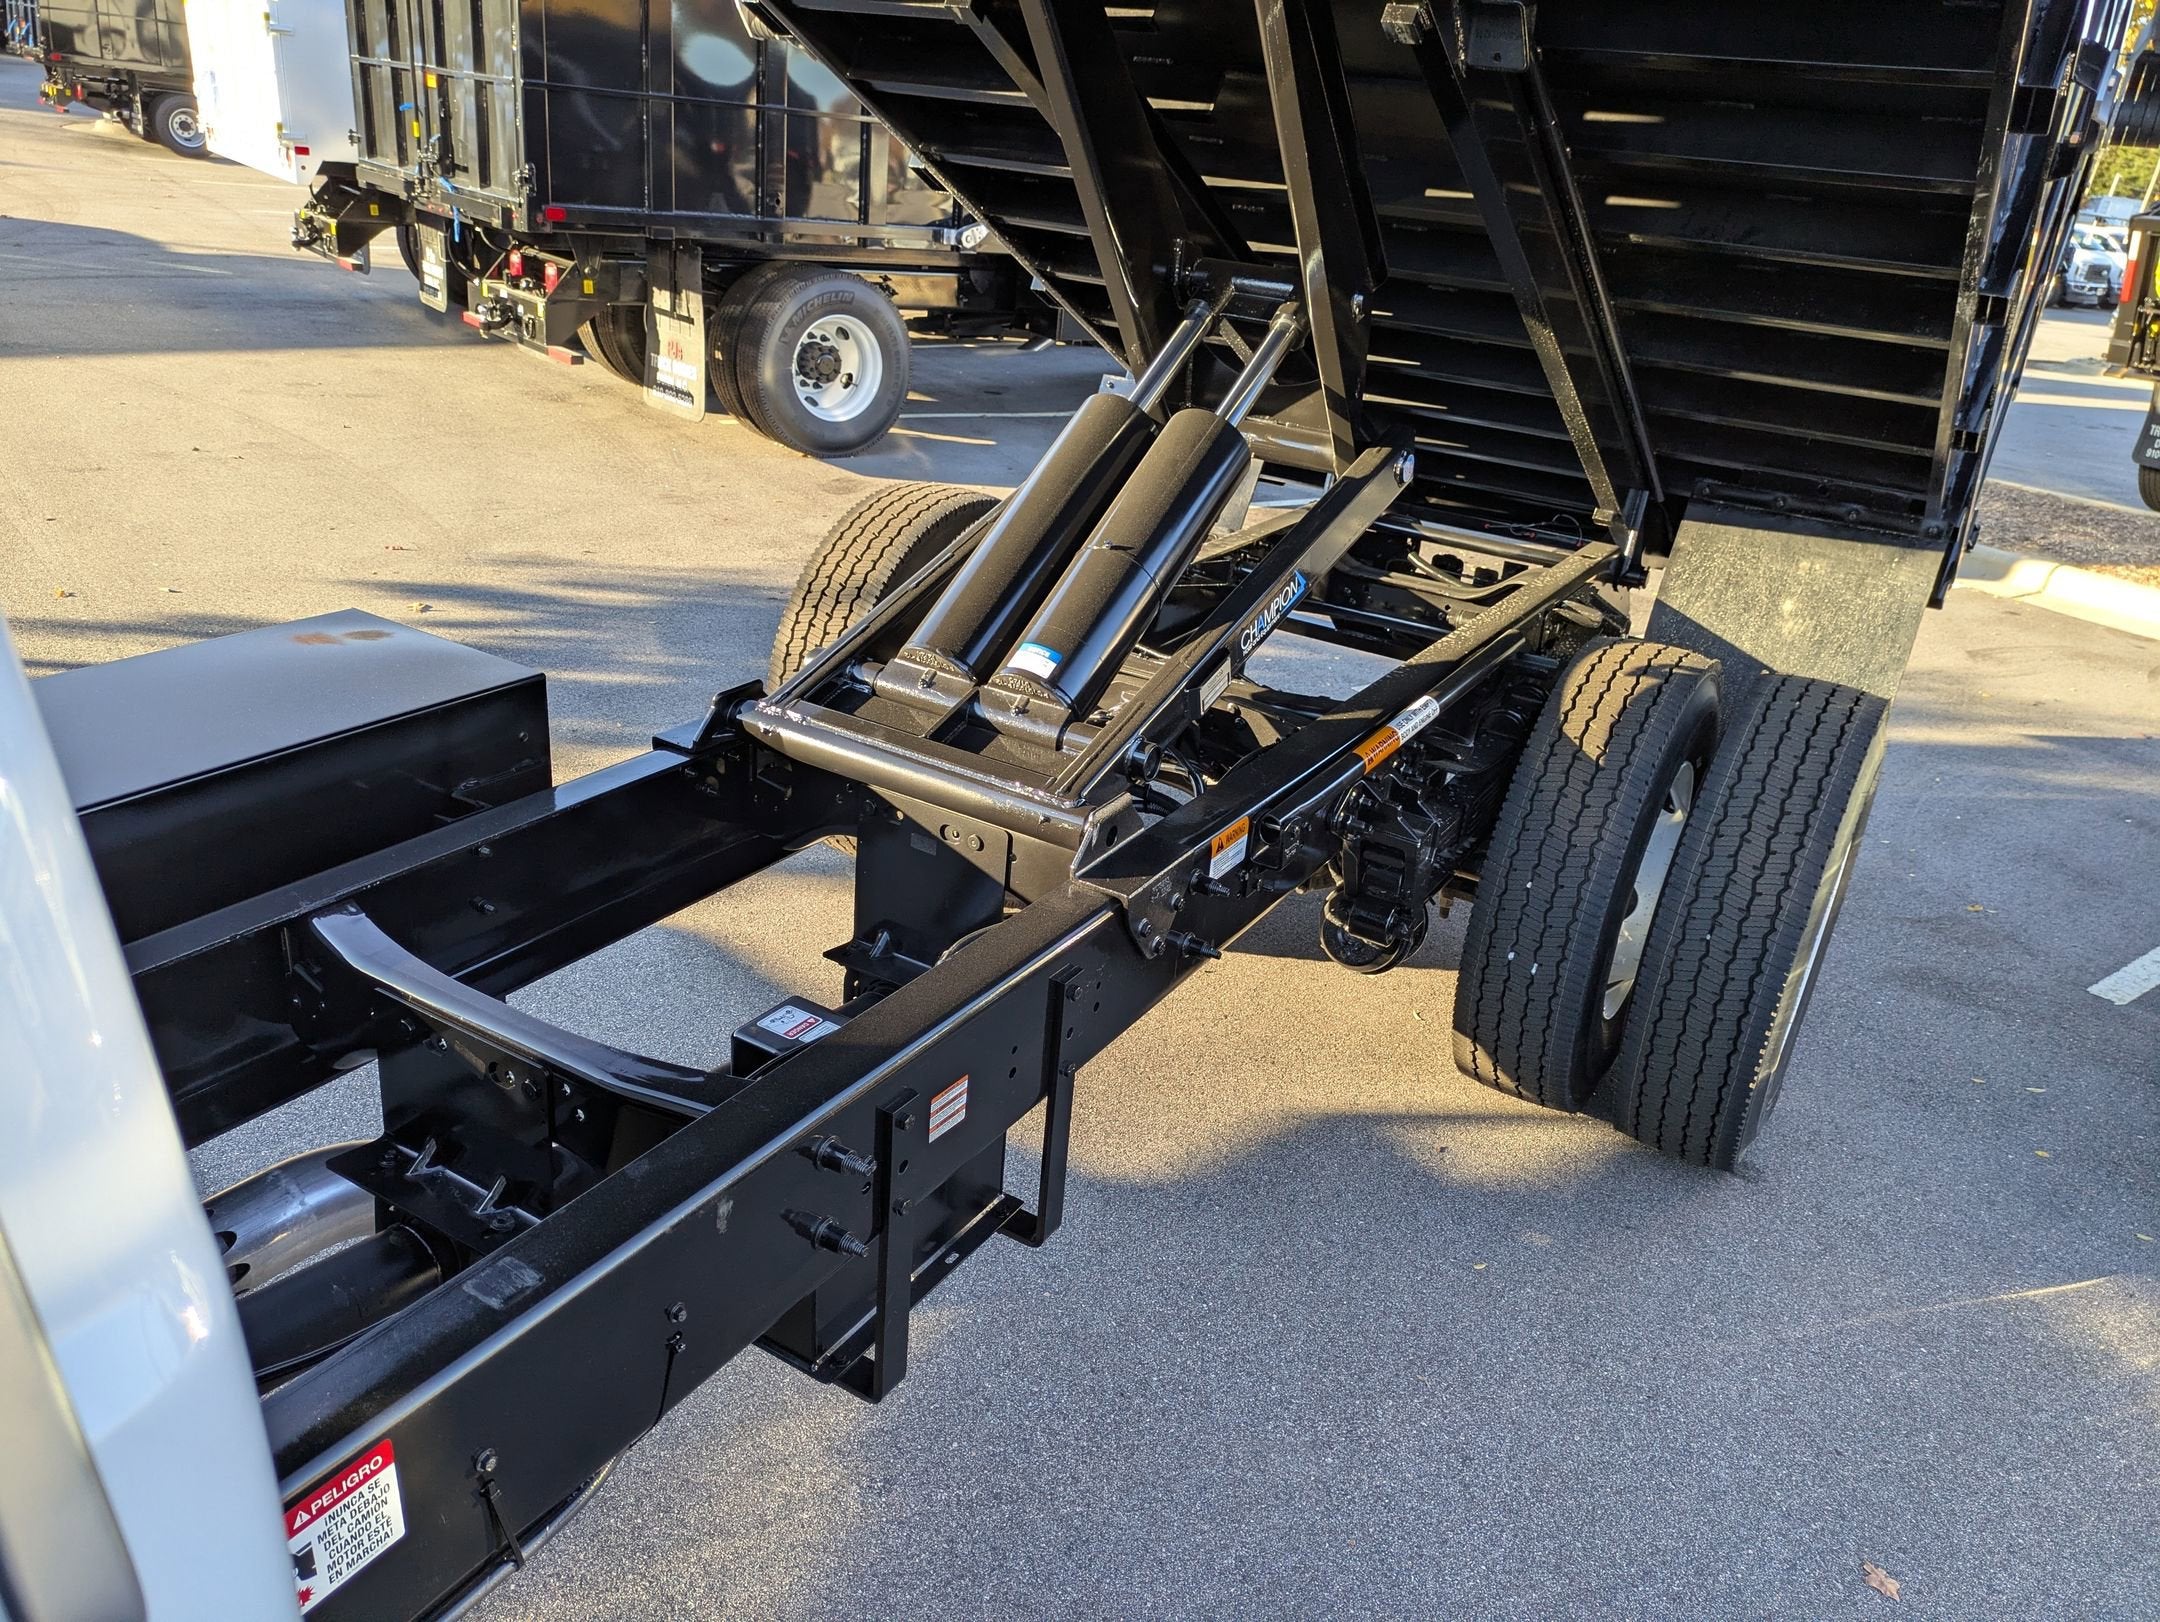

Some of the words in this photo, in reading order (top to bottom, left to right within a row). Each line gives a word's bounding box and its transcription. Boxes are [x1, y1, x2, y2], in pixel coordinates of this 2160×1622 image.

[793, 291, 855, 323] MICHELIN
[1241, 577, 1298, 650] CHAMPION
[1369, 730, 1400, 758] WARNING
[310, 1455, 383, 1515] PELIGRO
[367, 1478, 381, 1493] SE
[317, 1518, 347, 1545] META
[350, 1483, 390, 1519] DEBAJO
[323, 1533, 344, 1551] DEL
[346, 1496, 388, 1533] CAMIÓN
[329, 1522, 372, 1560] CUANDO
[375, 1511, 388, 1525] EL
[326, 1540, 365, 1574] MOTOR
[367, 1515, 393, 1542] ESTÉ
[328, 1568, 343, 1584] EN
[346, 1530, 394, 1571] MARCHA!
